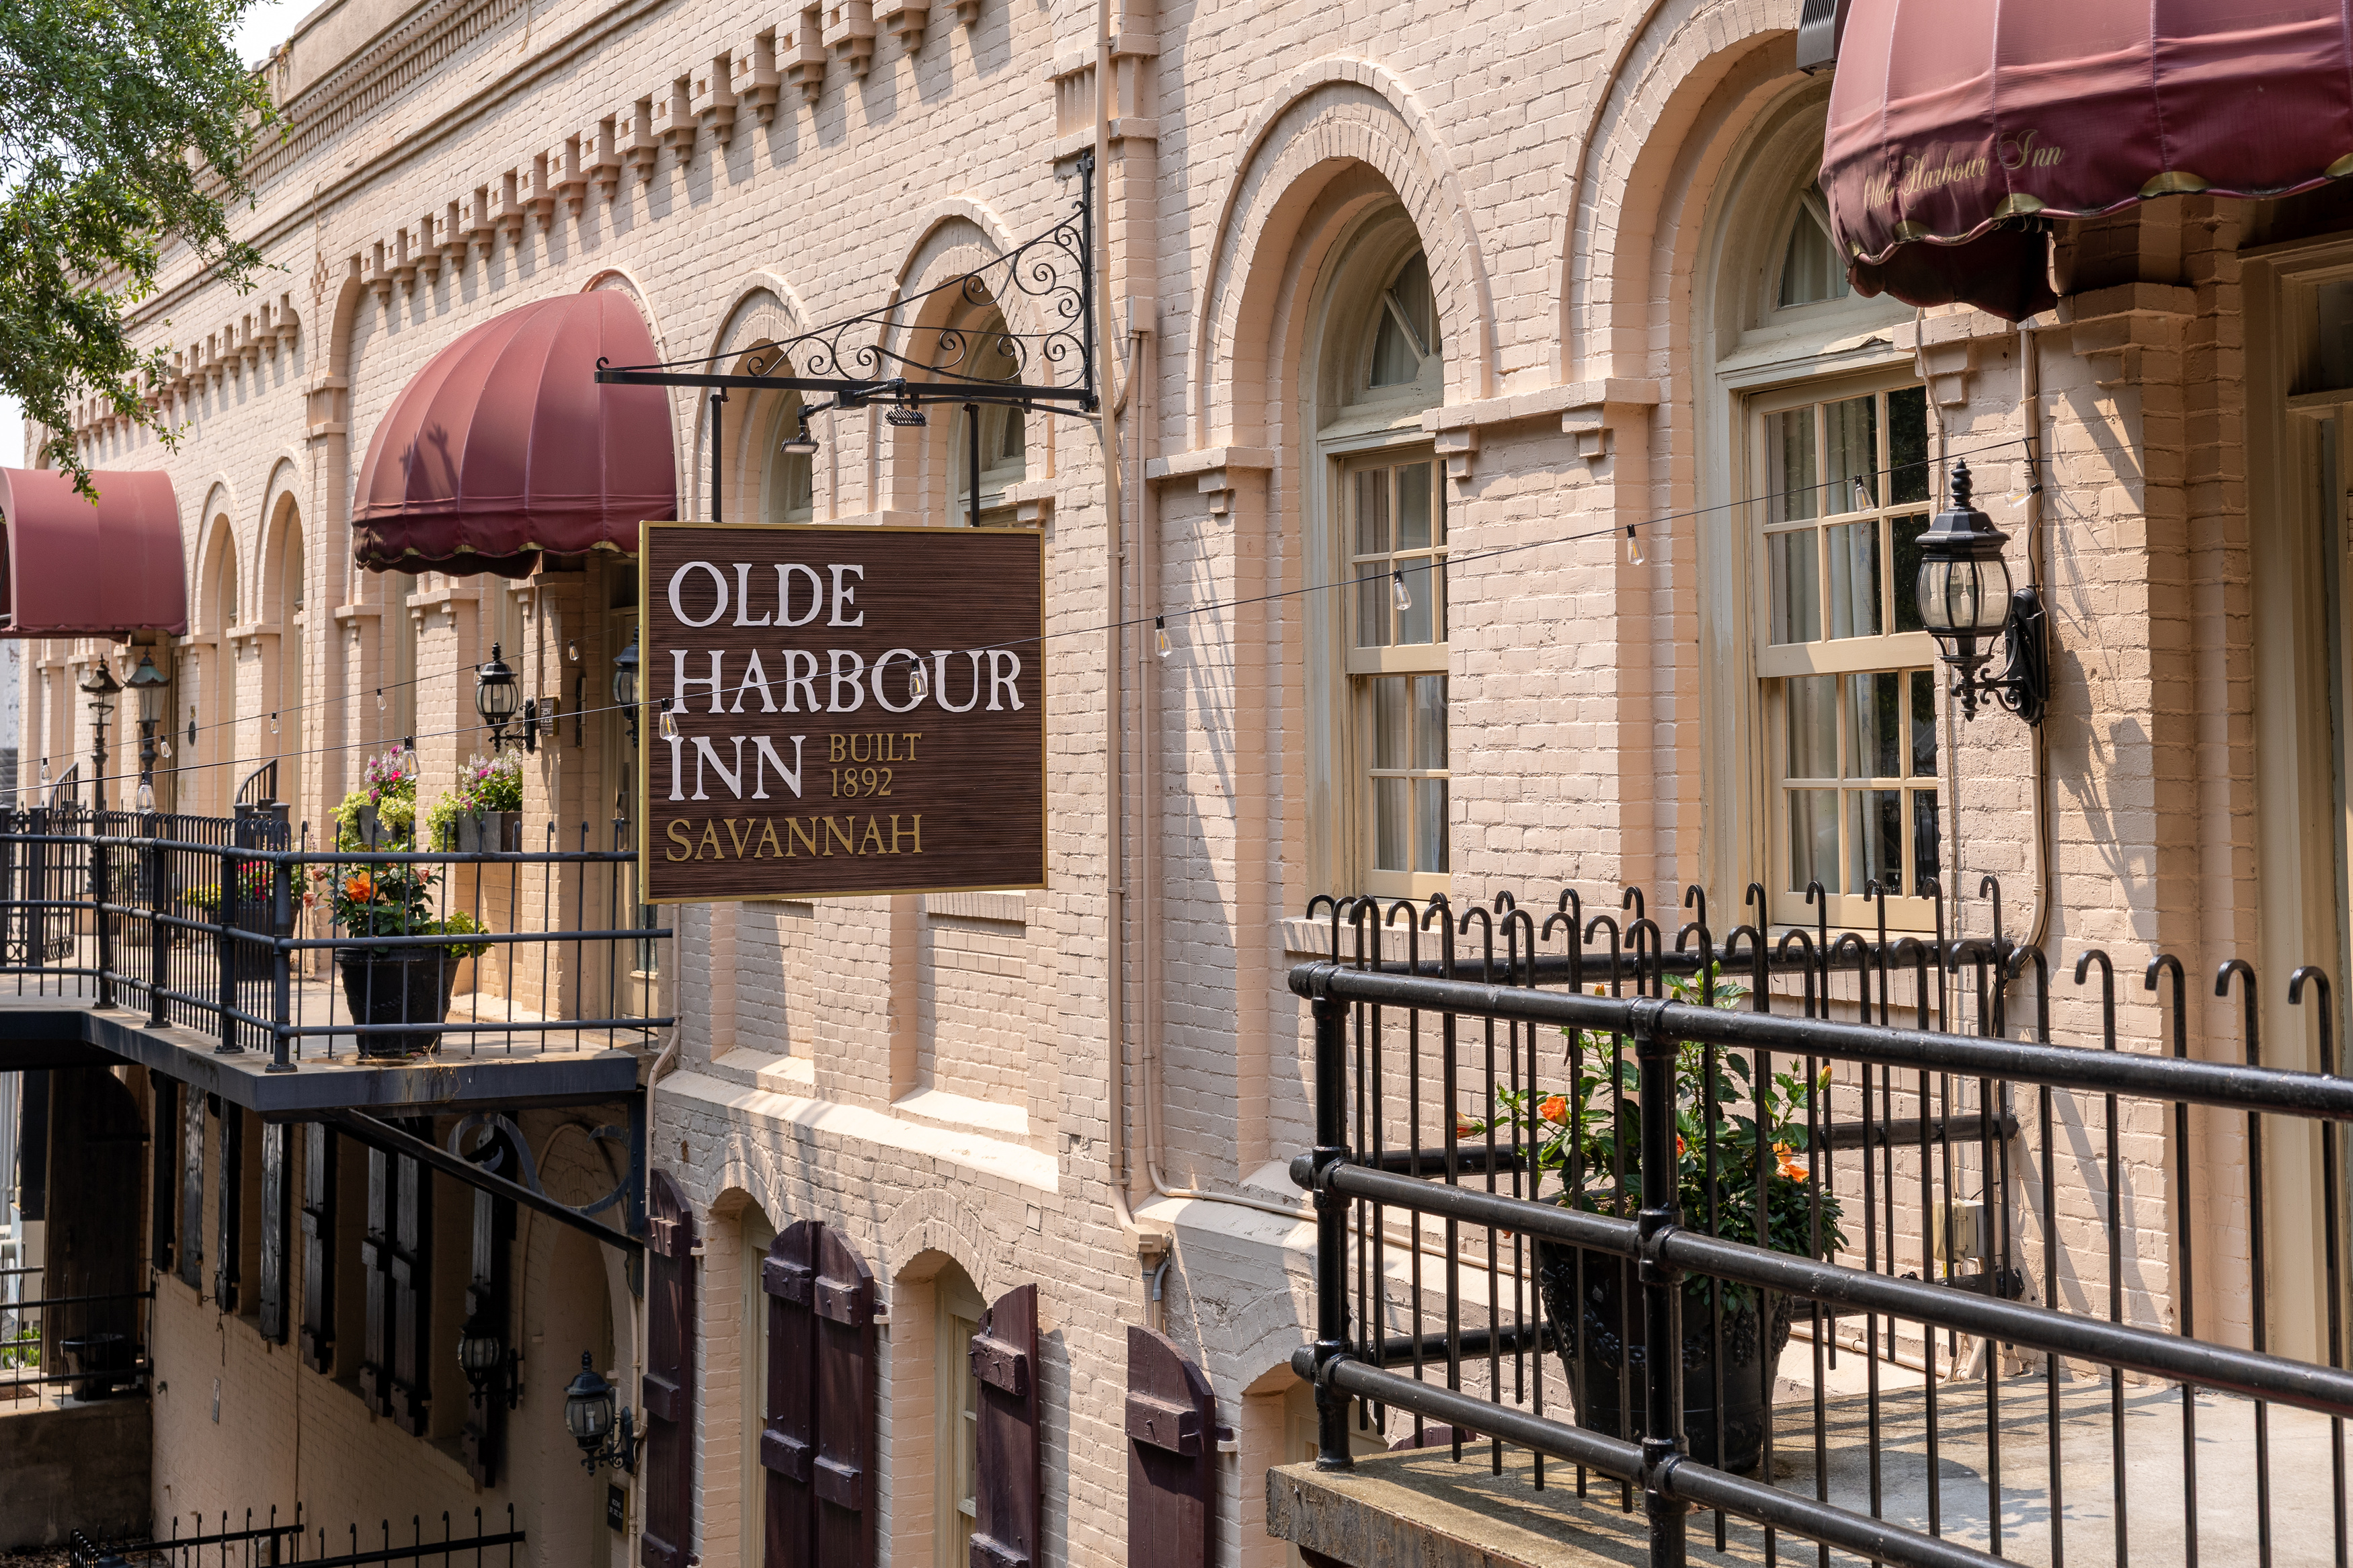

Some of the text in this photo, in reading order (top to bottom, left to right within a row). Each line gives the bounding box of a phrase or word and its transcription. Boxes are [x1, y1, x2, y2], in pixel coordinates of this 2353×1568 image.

[1864, 129, 2065, 210] Olde Harbour Inn
[668, 561, 864, 627] OLDE
[669, 648, 1025, 713] HARBOUR
[668, 735, 806, 801] INN
[828, 732, 922, 762] BUILT
[830, 766, 892, 797] 1892
[666, 814, 923, 862] SAVANNAH
